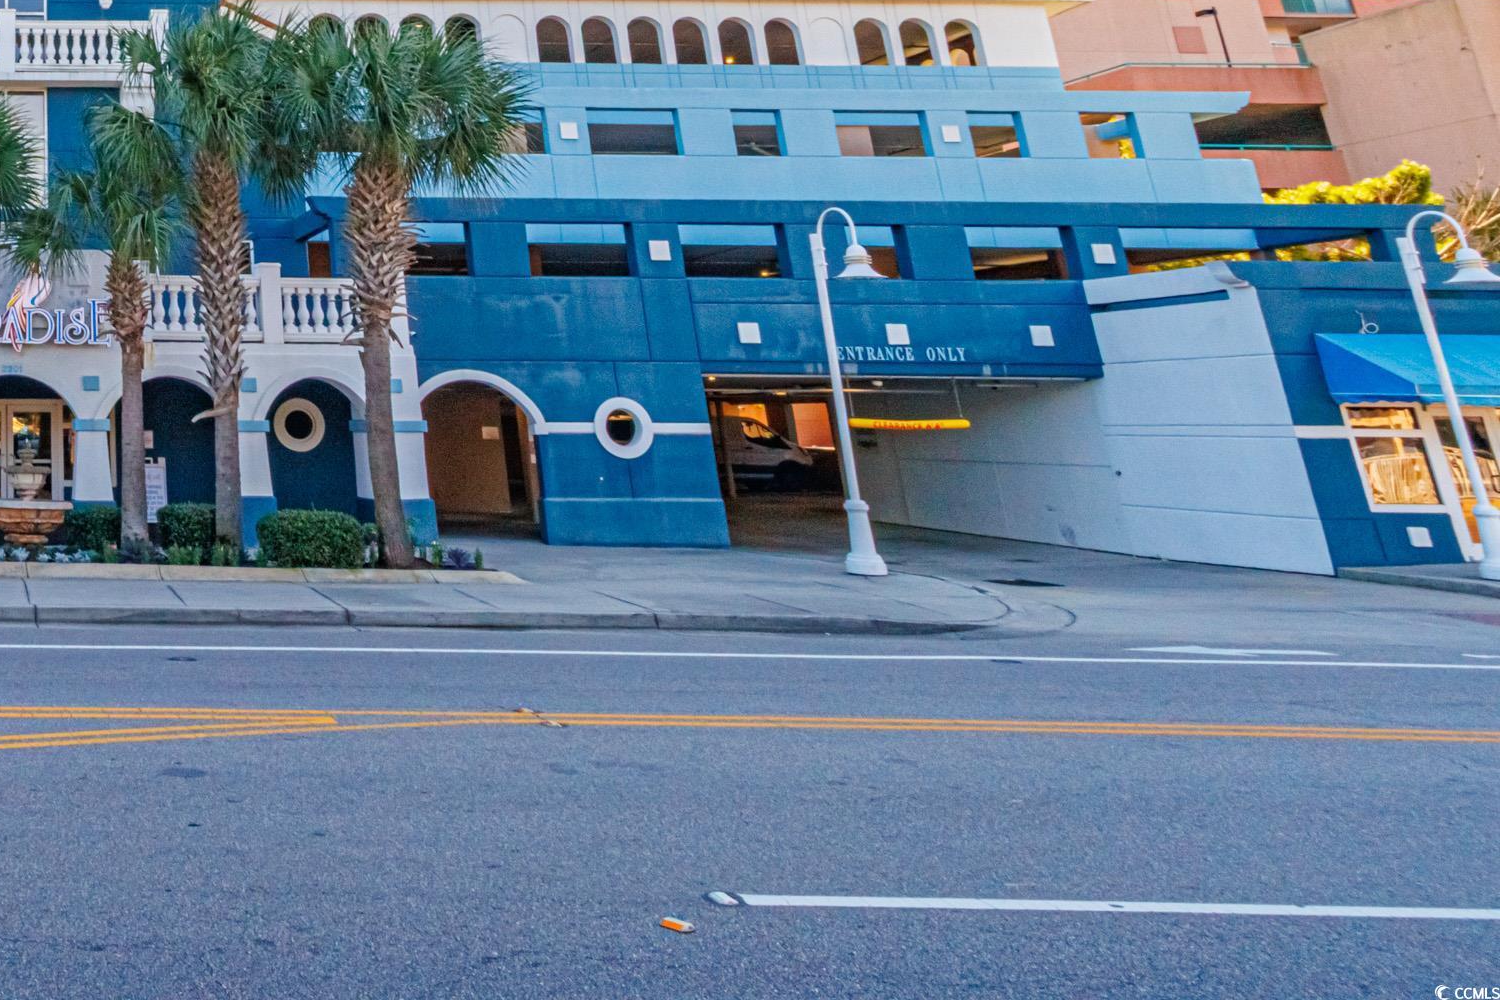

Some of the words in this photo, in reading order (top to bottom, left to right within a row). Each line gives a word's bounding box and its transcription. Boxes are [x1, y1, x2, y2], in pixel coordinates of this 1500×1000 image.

[836, 346, 915, 361] ENTRANCE
[926, 346, 966, 362] ONLY
[873, 420, 922, 431] CLEARANCE
